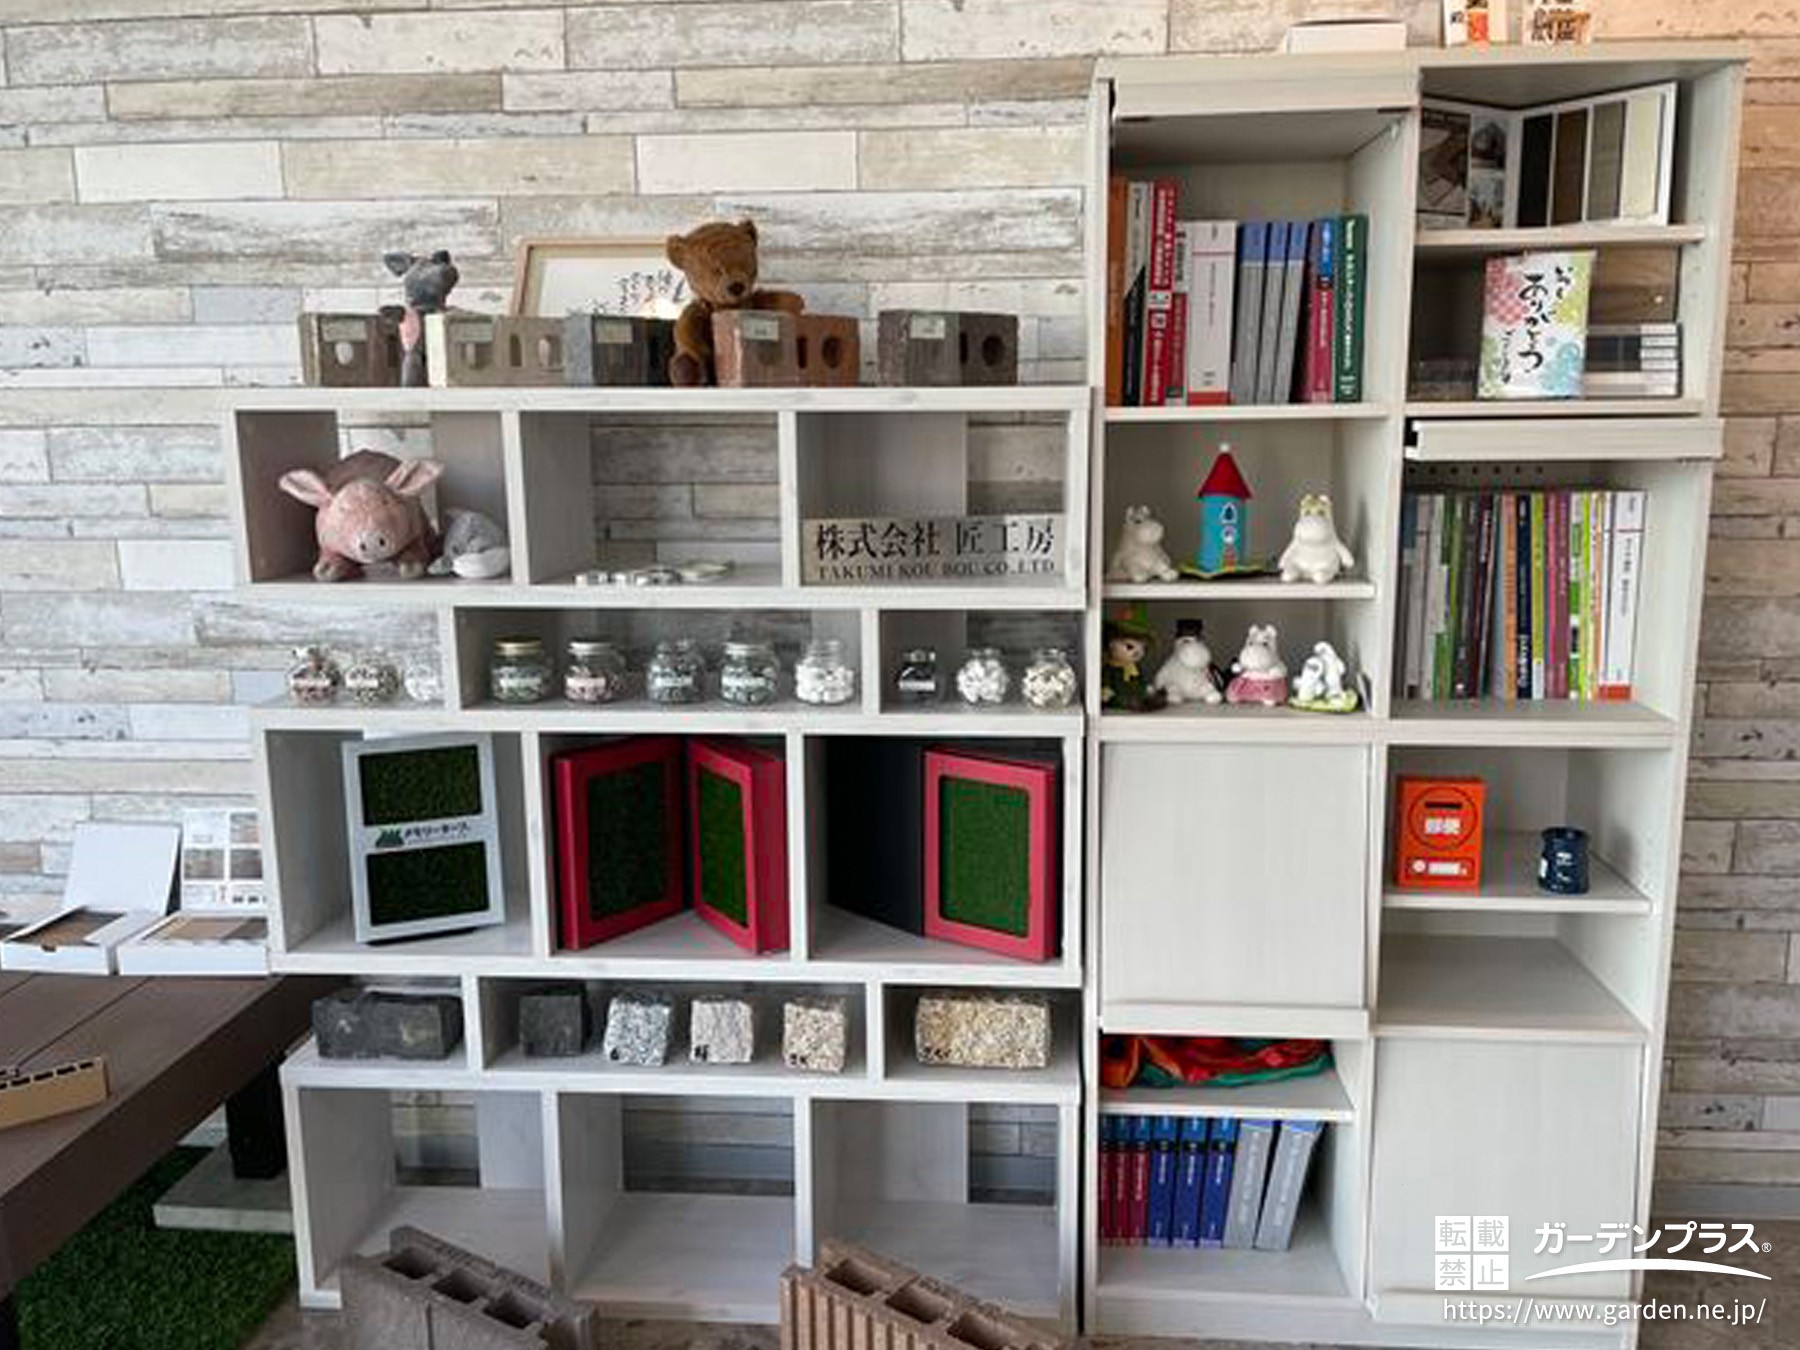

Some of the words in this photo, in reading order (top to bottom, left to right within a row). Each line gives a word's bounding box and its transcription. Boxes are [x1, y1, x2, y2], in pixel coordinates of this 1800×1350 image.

[816, 521, 940, 559] 株式会社
[956, 518, 1054, 554] 匠工房
[819, 562, 892, 579] TAKUMI
